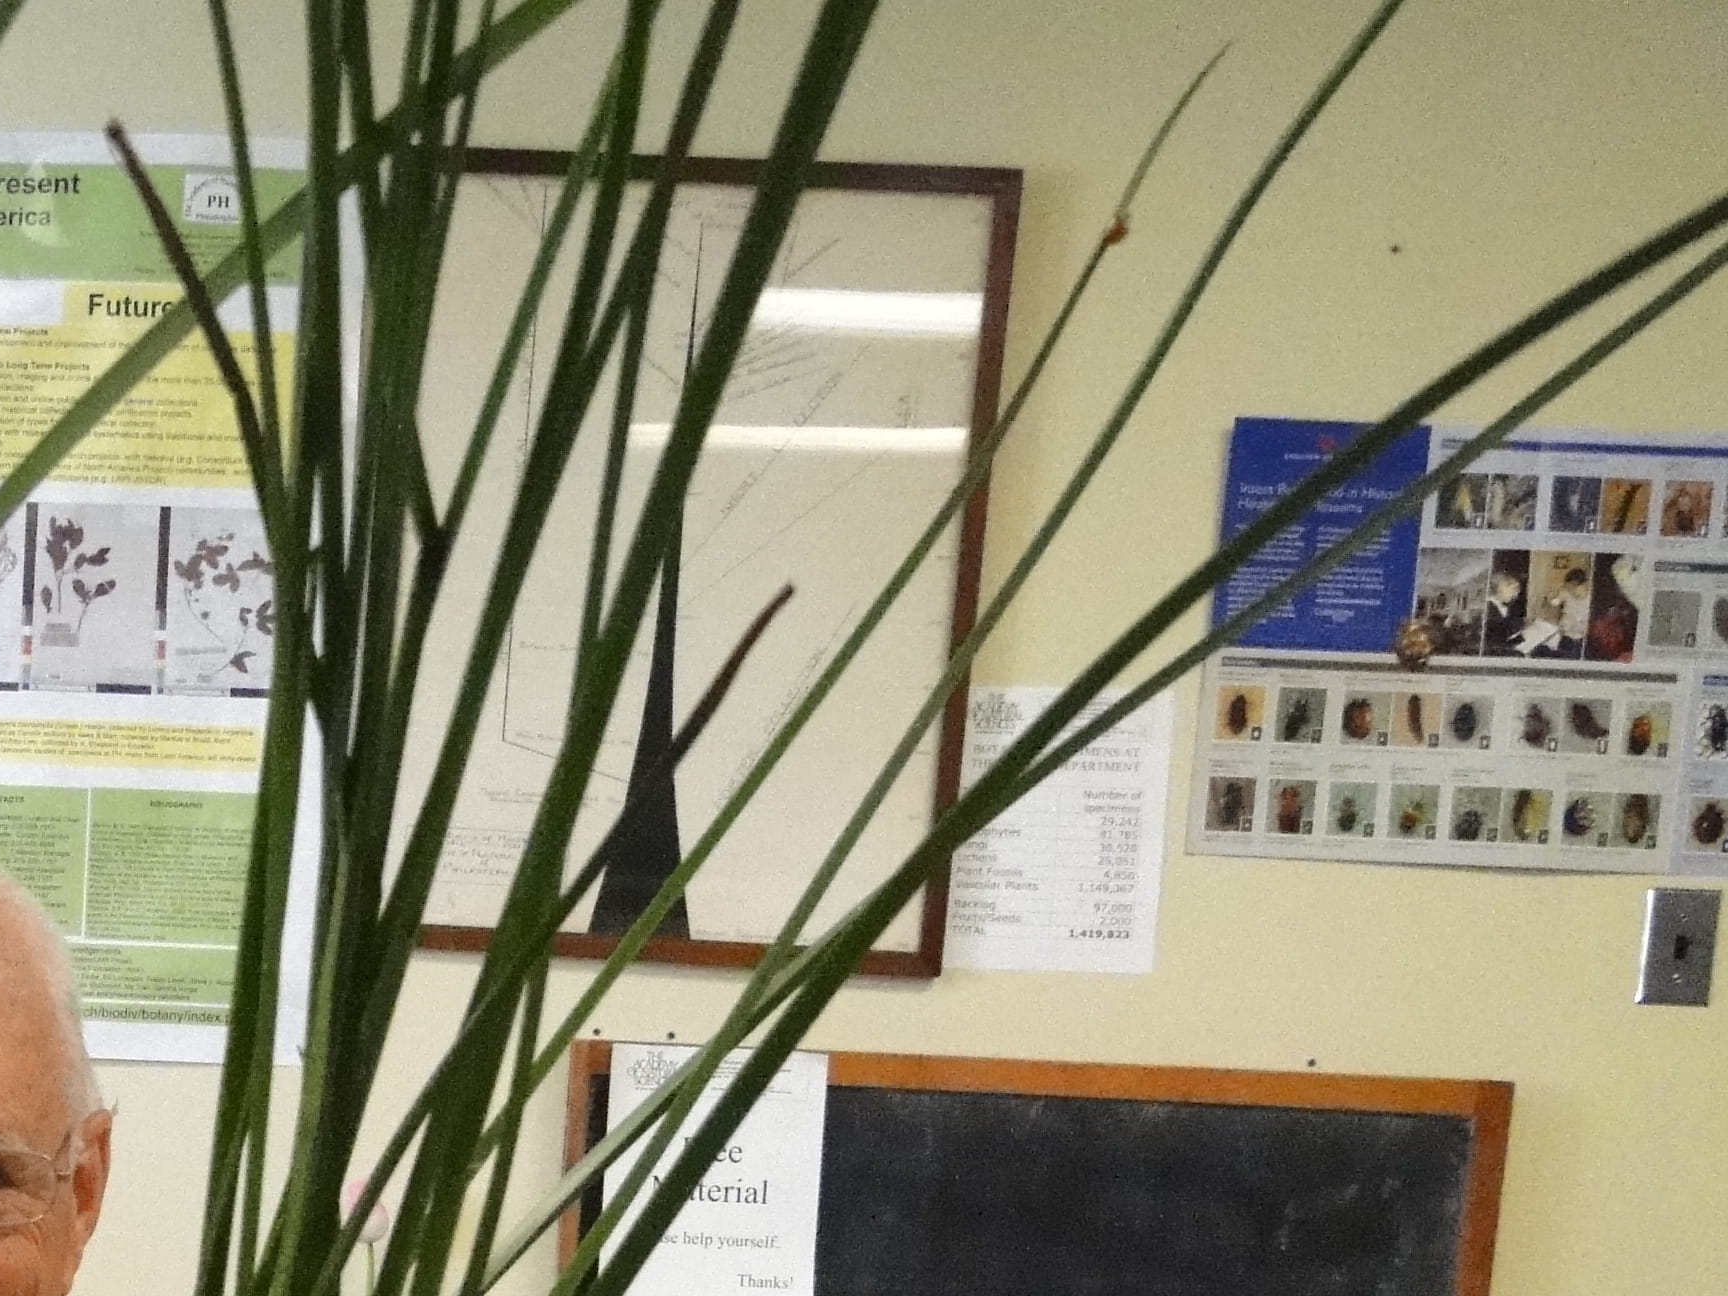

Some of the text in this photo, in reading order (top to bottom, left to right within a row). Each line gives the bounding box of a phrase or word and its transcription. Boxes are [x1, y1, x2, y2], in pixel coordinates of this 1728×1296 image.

[952, 924, 1131, 941] TOTAL 1,419,823
[683, 1231, 714, 1249] help
[737, 1273, 794, 1289] Thanks!
